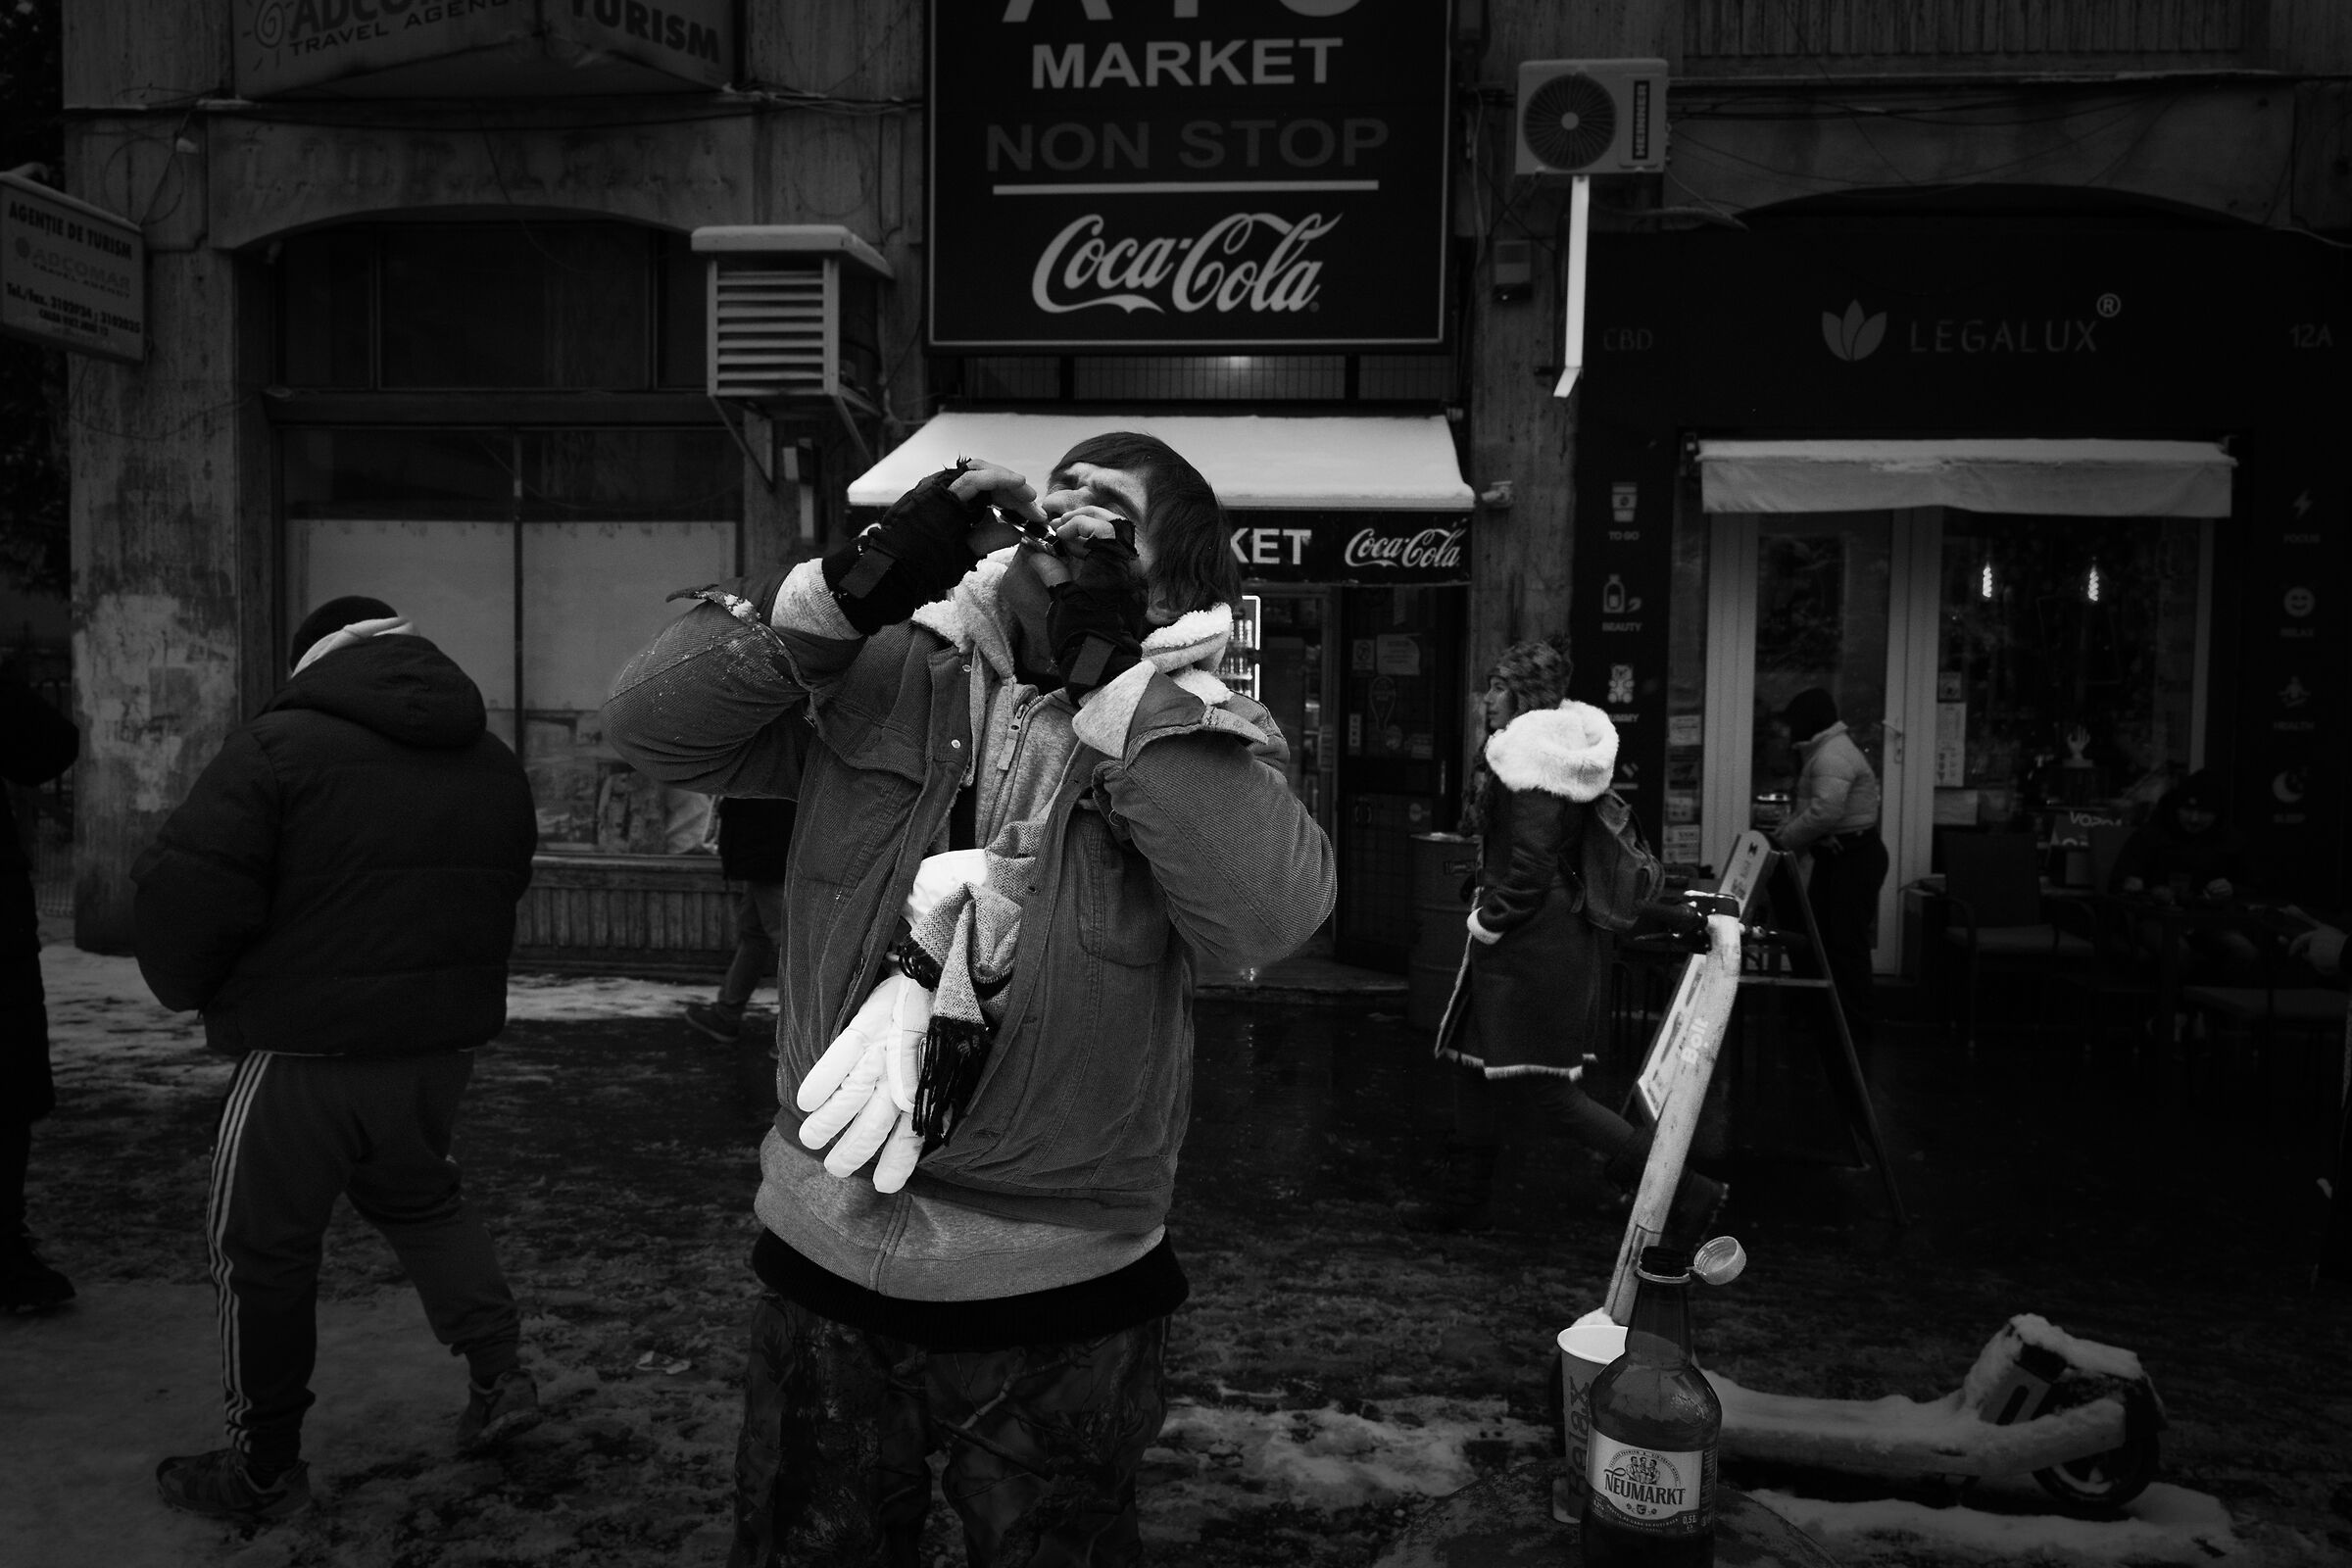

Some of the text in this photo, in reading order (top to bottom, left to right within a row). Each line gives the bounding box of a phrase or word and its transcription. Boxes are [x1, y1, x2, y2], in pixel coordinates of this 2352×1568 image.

[290, 0, 510, 57] TRAVEL AGEN
[1032, 37, 1344, 89] MARKET
[987, 118, 1389, 172] NON STOP
[68, 220, 84, 243] DE
[87, 227, 133, 261] TURISM
[32, 248, 131, 291] ADCOMAR
[1032, 212, 1344, 315] Coca-Cola
[1602, 326, 1654, 353] CBD
[1910, 318, 2098, 354] LEGALUX
[2289, 321, 2334, 349] 12A
[1230, 527, 1313, 565] KET
[1345, 527, 1467, 568] Coca-Cola
[1608, 530, 1640, 541] TO GO
[1601, 620, 1643, 632] BEAUTY
[1604, 1469, 1686, 1505] NEUMARKT
